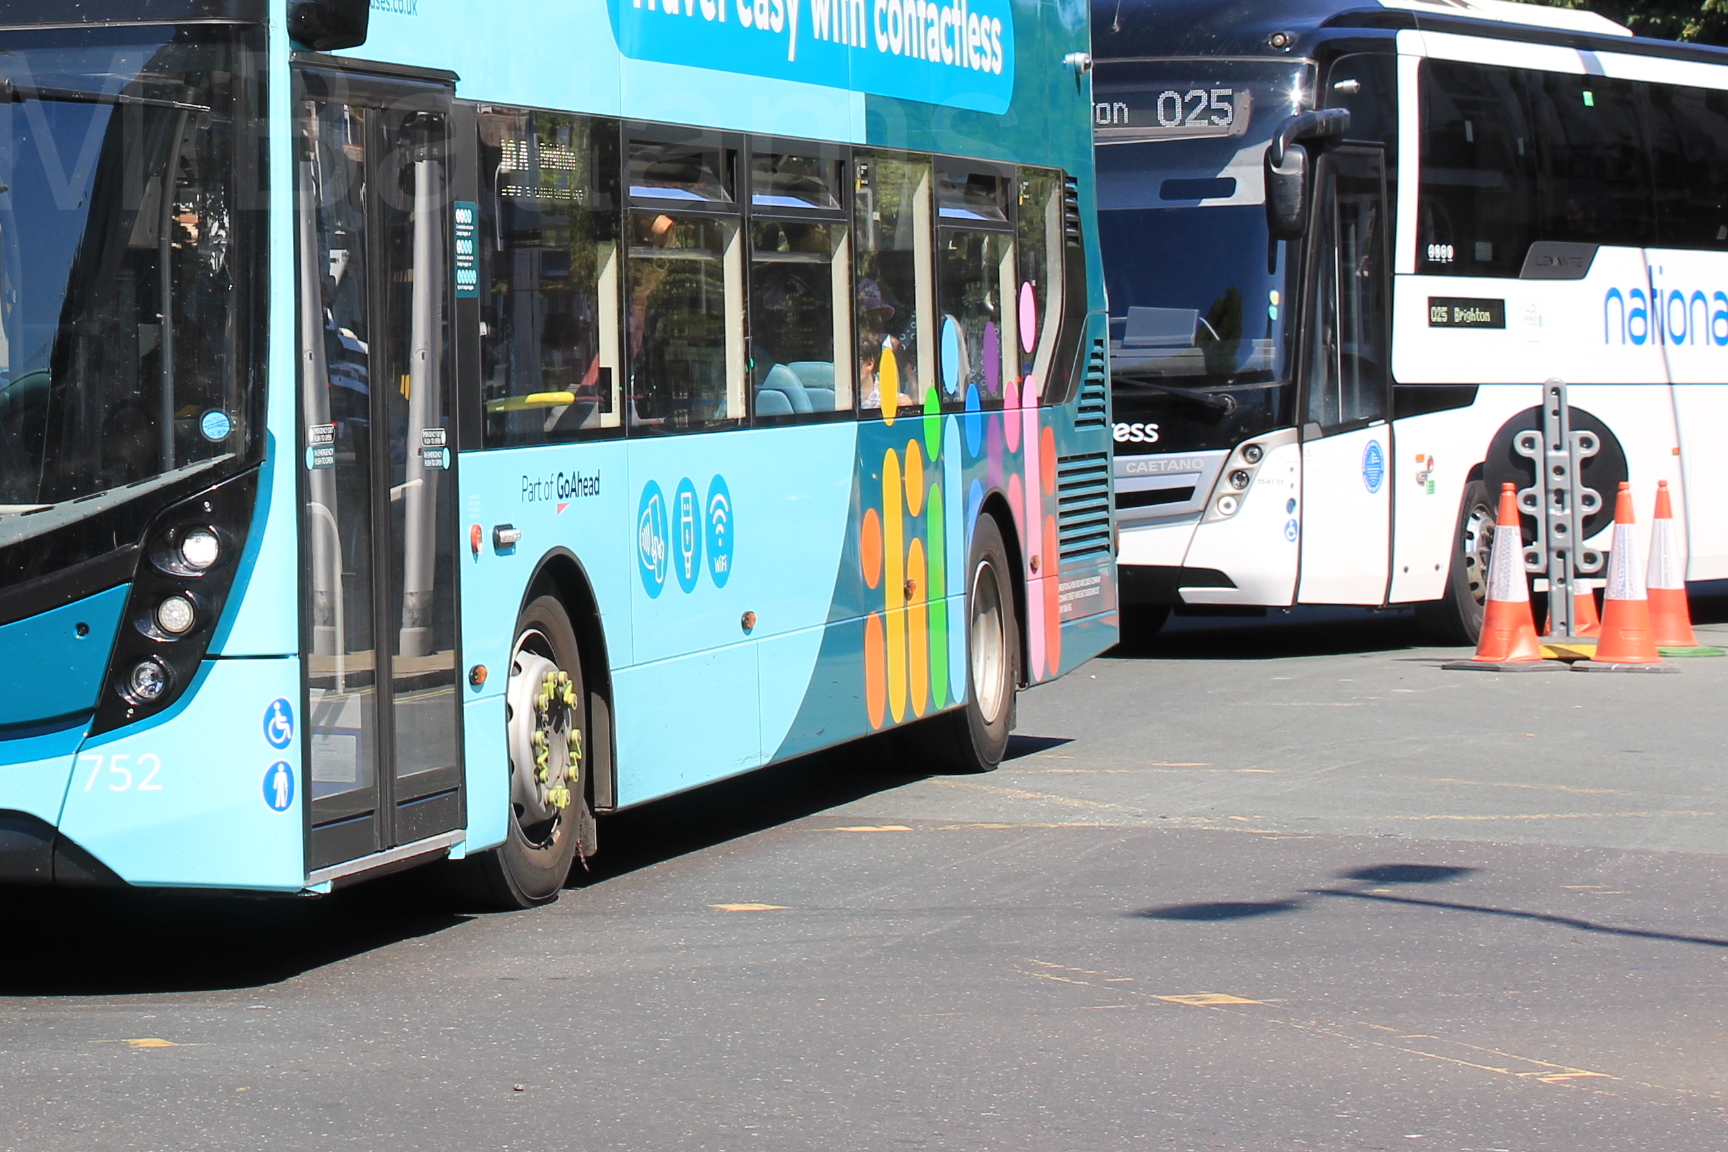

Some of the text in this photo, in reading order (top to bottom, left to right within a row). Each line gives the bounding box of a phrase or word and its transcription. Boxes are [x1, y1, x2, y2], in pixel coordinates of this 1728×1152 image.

[1094, 88, 1233, 127] on 025
[1536, 255, 1583, 268] LEVANTE
[1430, 306, 1491, 323] 025 Brighton
[1604, 265, 1728, 346] nationa
[1111, 422, 1160, 443] ess
[1126, 458, 1204, 473] CAETANO
[522, 469, 600, 502] Part of GoAhead
[714, 554, 728, 573] WiFi
[81, 752, 163, 794] 752
